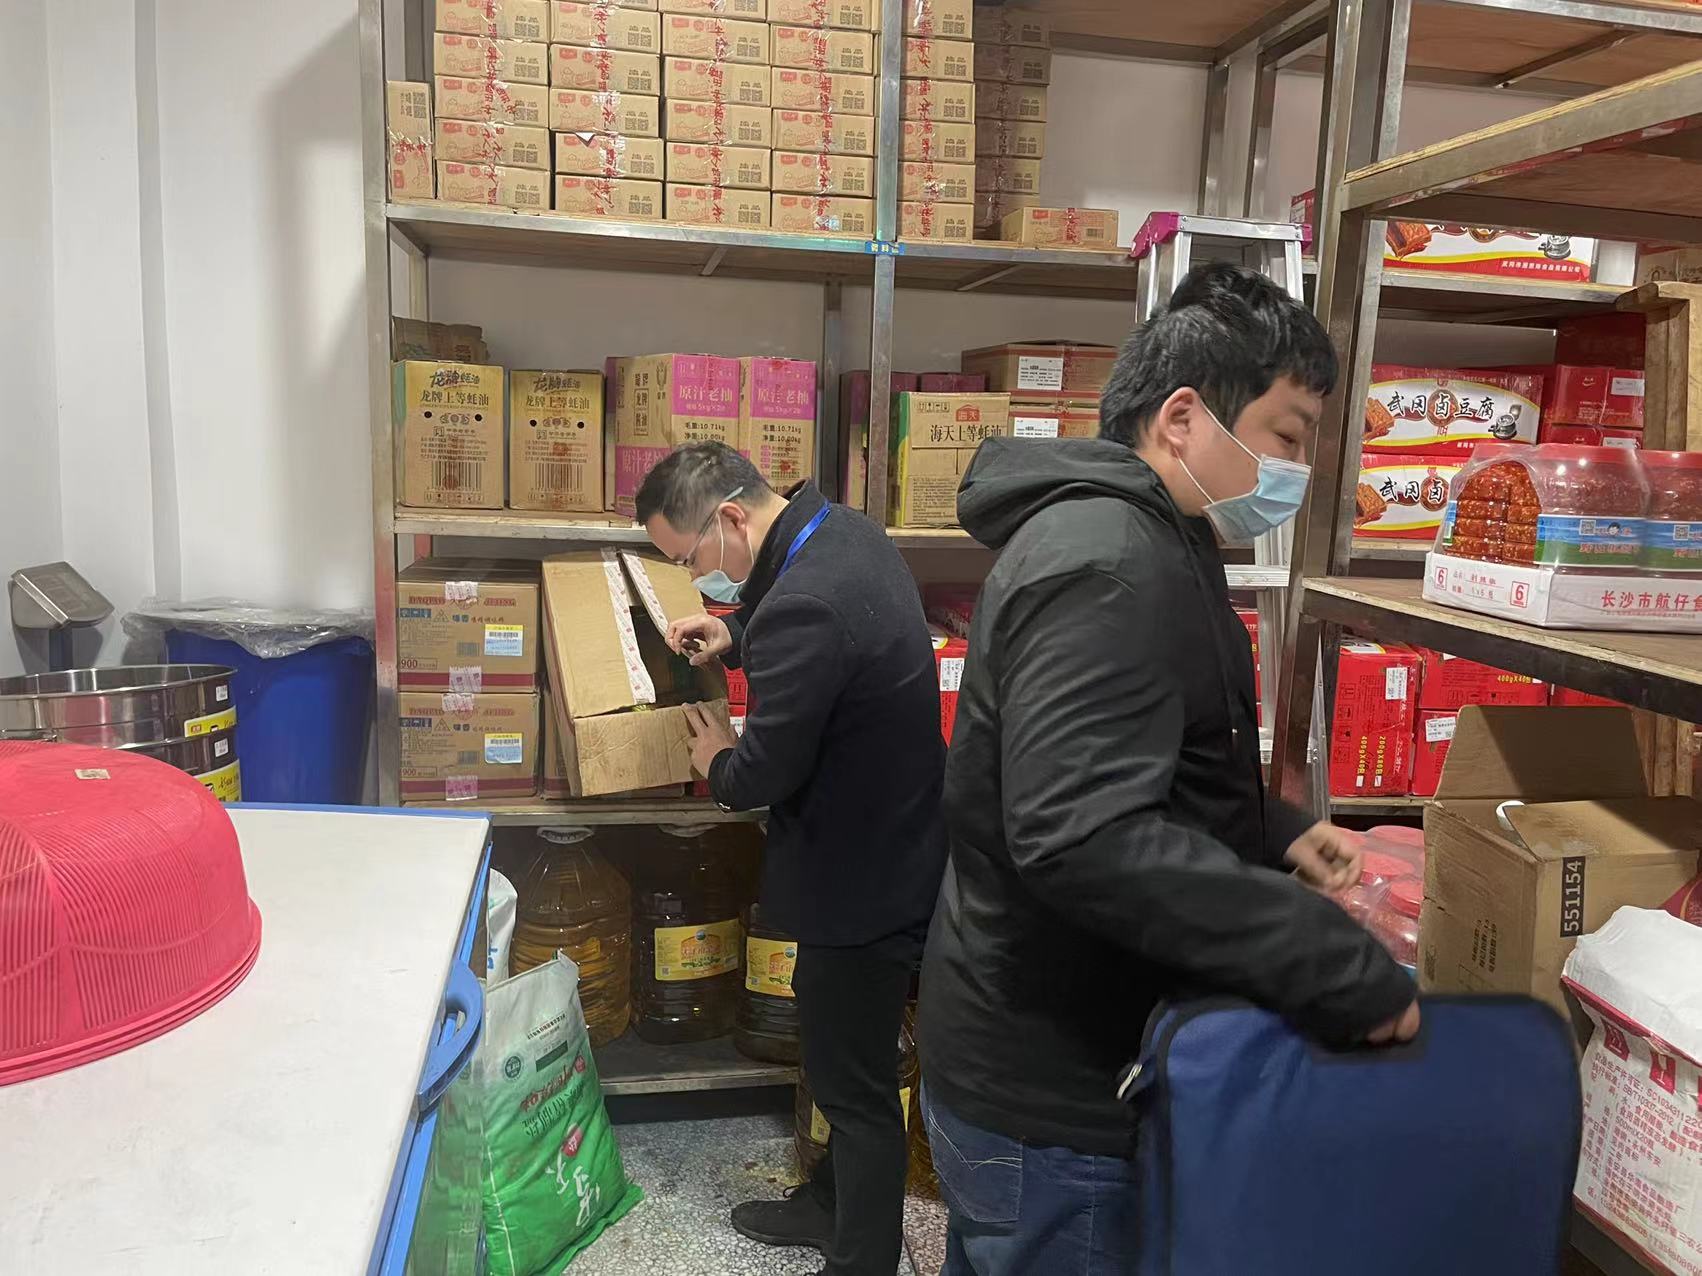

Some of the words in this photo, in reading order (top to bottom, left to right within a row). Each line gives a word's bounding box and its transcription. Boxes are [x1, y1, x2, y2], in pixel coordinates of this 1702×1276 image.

[420, 389, 489, 406] 龙牌上等蚝油
[680, 385, 733, 402] 原汁老抽
[527, 395, 590, 410] 龙牌上等蚝油
[1386, 390, 1495, 420] 武冈卤豆腐
[958, 410, 978, 421] 海天
[930, 424, 1002, 442] 海天上等蚝油
[1379, 477, 1443, 502] 武冈卤
[1436, 568, 1445, 584] 6
[1515, 584, 1525, 601] 6
[400, 658, 418, 669] 900
[1564, 860, 1582, 933] 551154
